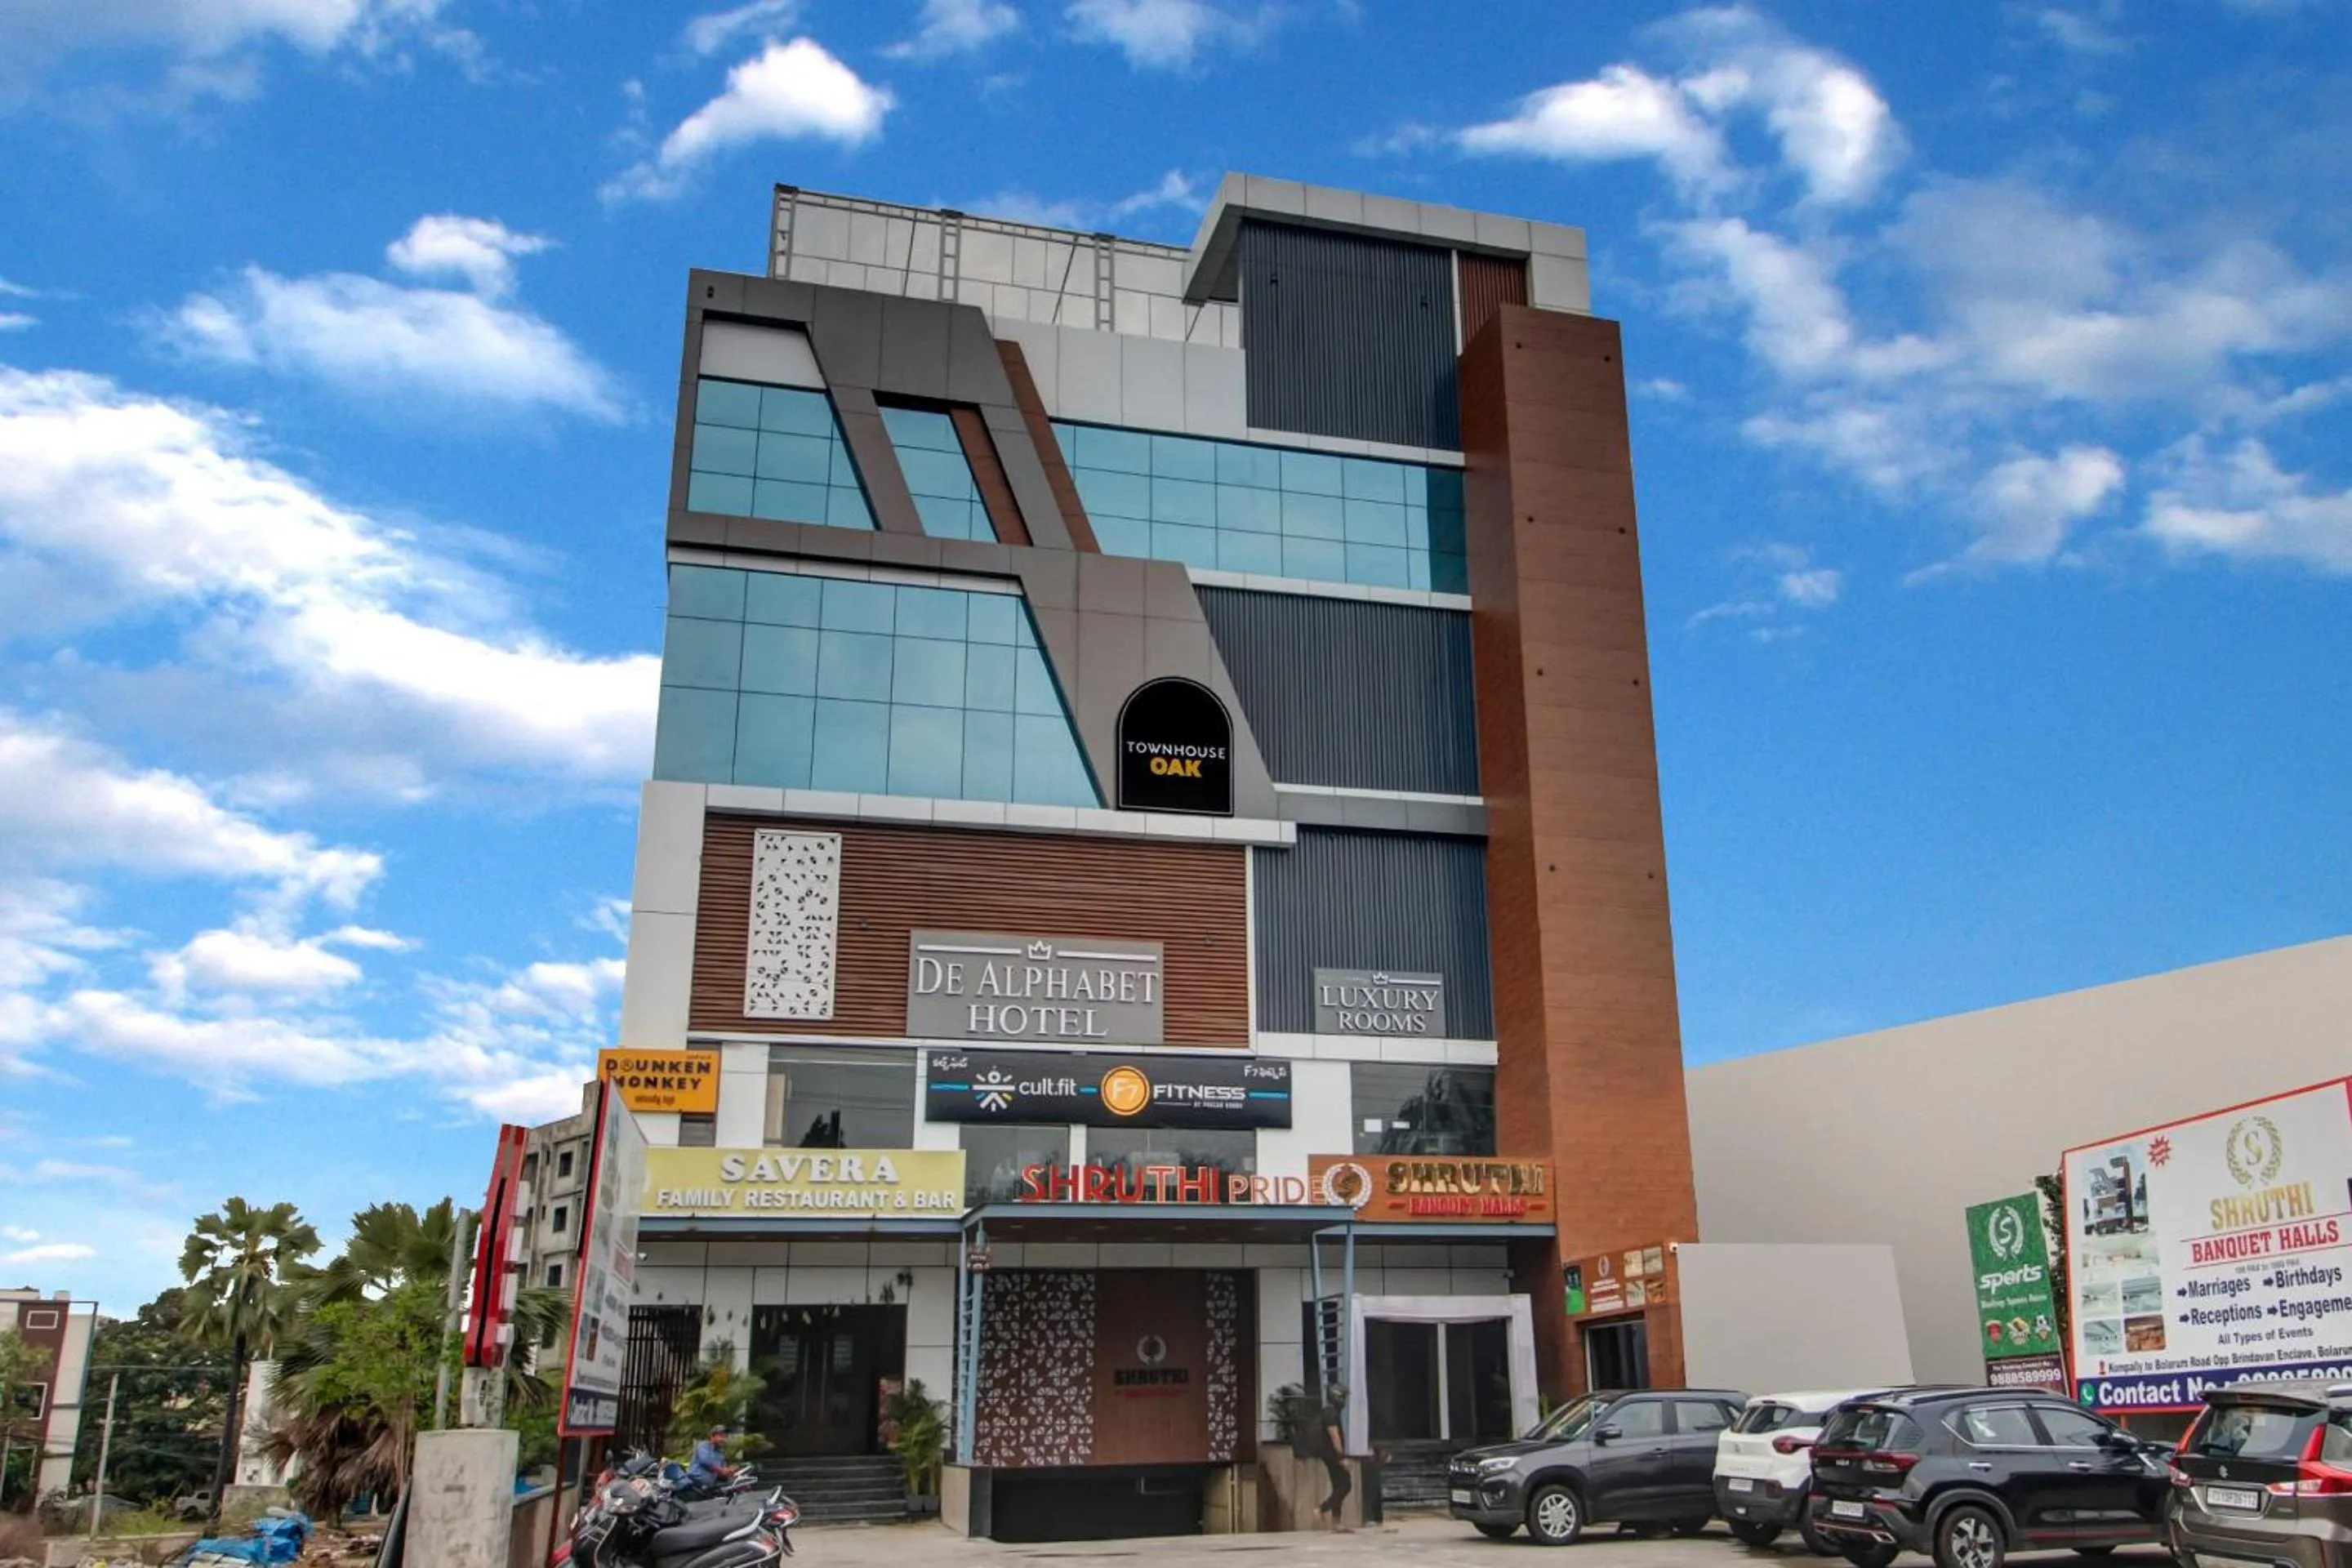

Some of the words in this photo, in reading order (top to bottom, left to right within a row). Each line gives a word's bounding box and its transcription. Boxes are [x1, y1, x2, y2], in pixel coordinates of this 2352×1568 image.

[1127, 741, 1226, 760] TOWNHOUSE
[1150, 756, 1202, 778] OAK
[976, 960, 1160, 1004] ALPHABET
[1321, 986, 1438, 1012] LUXURY
[966, 1004, 1110, 1037] HOTEL
[1339, 1011, 1427, 1033] ROOMS
[1018, 1078, 1078, 1096] cult.fit
[1111, 1076, 1138, 1102] F7
[1152, 1084, 1246, 1101] FITNESS
[2245, 1130, 2263, 1165] S
[720, 1152, 898, 1183] SAVERA
[1020, 1164, 1220, 1204] SHRUTHI
[1227, 1174, 1325, 1204] PRIDE
[656, 1187, 736, 1209] FAMILY
[744, 1188, 889, 1209] RESTAURANT
[893, 1189, 906, 1209] &
[912, 1190, 956, 1209] BAR
[2210, 1183, 2314, 1231] SHRUTHI
[1999, 1217, 2011, 1245] S
[2192, 1229, 2271, 1263] BANQUET
[2278, 1220, 2339, 1250] HALLS
[1979, 1263, 2042, 1294] sports
[2188, 1276, 2252, 1298] Marriages
[2275, 1264, 2342, 1290] Birthdays
[2190, 1304, 2262, 1326] Receptions
[2217, 1334, 2231, 1344] All
[2234, 1330, 2263, 1346] Types
[2265, 1329, 2275, 1339] of
[2279, 1326, 2314, 1340] Events
[2189, 1356, 2211, 1367] Road
[2213, 1354, 2230, 1366] Opp
[2099, 1379, 2181, 1405] Contact
